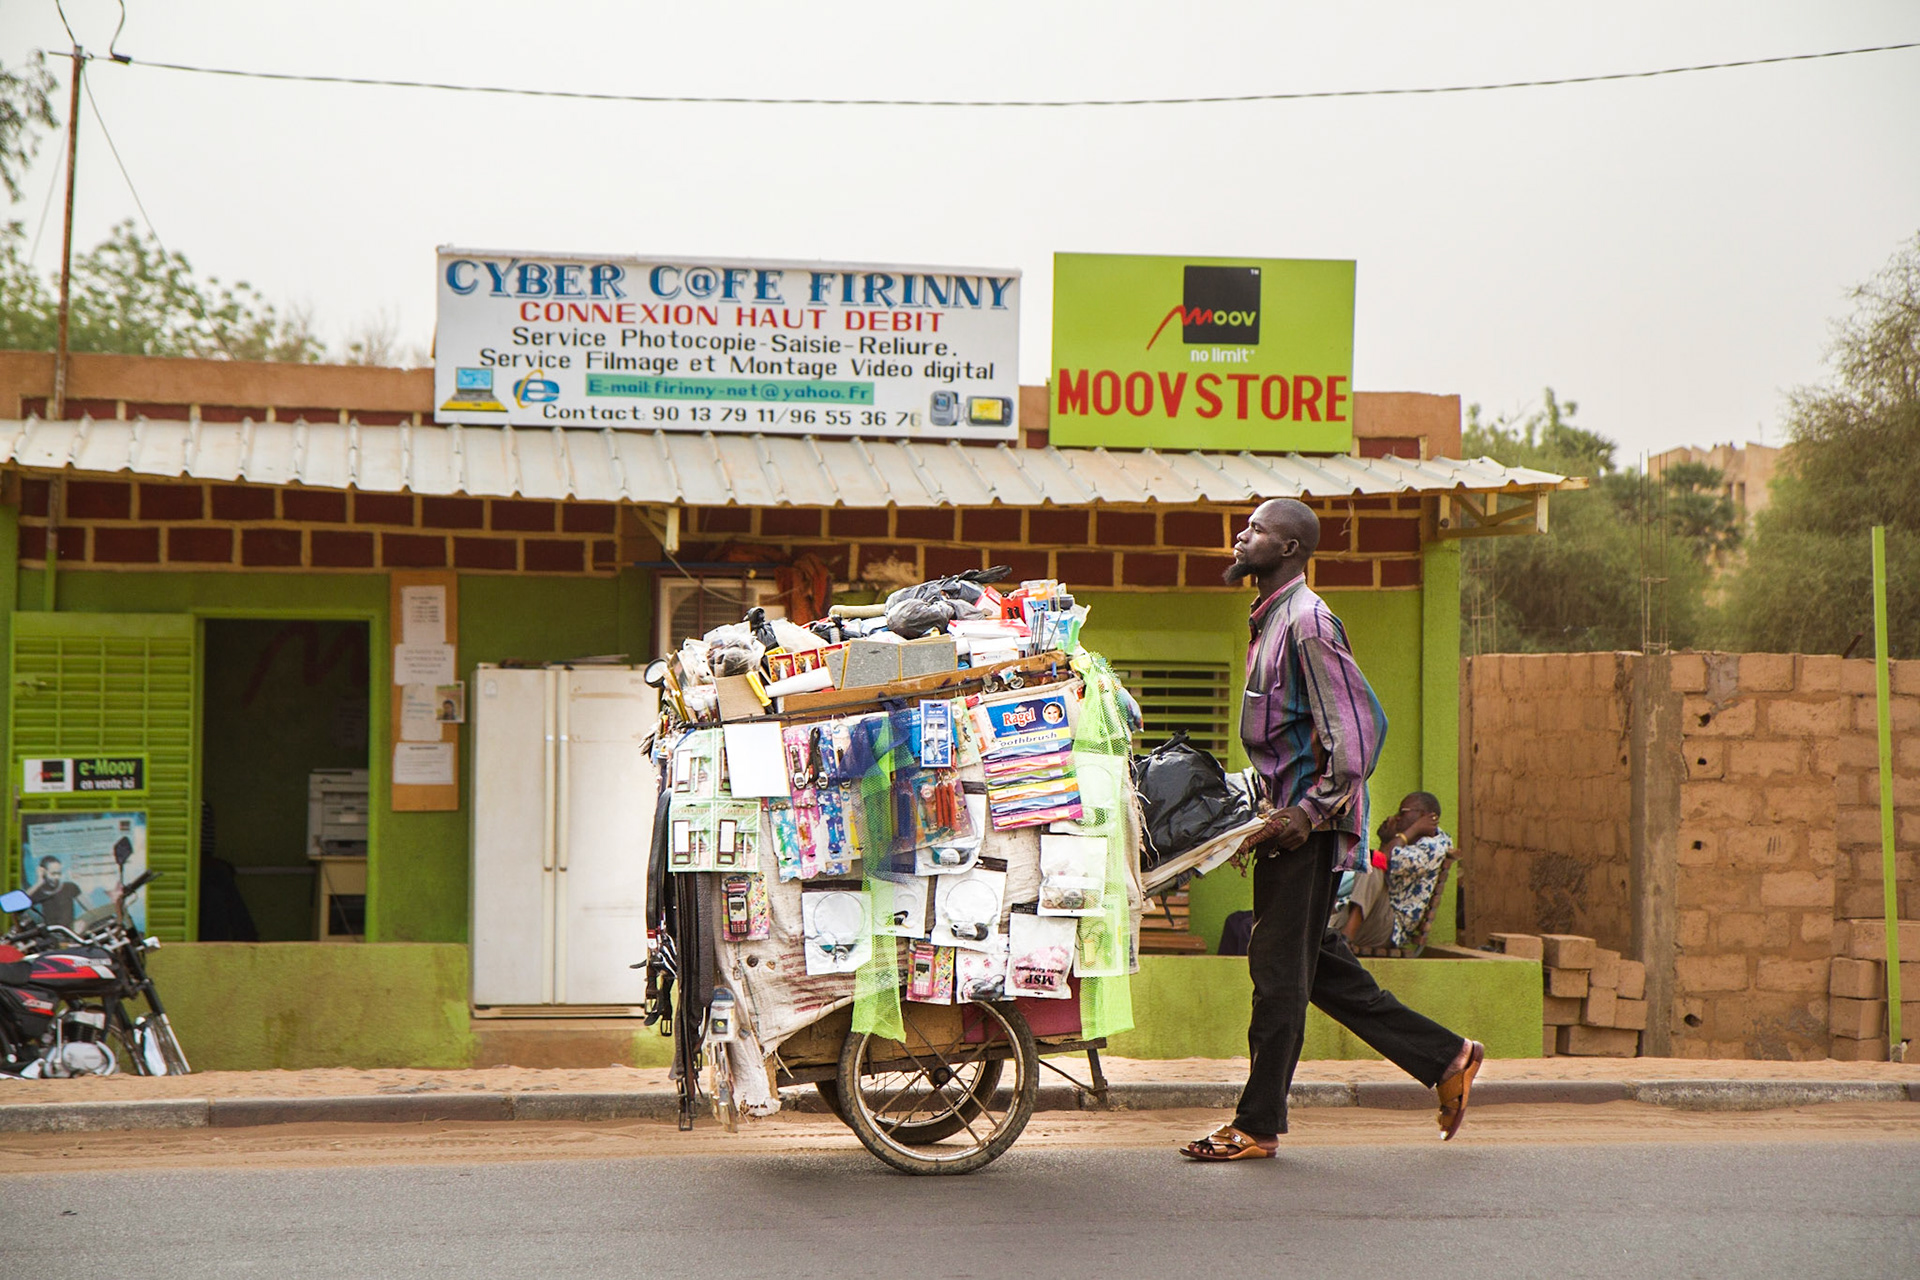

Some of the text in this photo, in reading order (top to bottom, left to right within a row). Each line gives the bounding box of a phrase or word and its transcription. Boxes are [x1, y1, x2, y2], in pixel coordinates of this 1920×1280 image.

[446, 259, 1014, 310] CYBER C@FE FIRINNY
[520, 302, 944, 332] CONNEXION HAUT DEBIT
[513, 327, 606, 347] Service
[1190, 349, 1209, 362] no
[480, 349, 571, 369] Service
[587, 352, 678, 375] Filmage
[690, 355, 715, 371] et
[730, 356, 837, 380] Montage
[924, 362, 994, 382] digital
[653, 406, 679, 421] 90
[690, 407, 711, 421] 13
[721, 407, 747, 422] 79
[826, 410, 851, 425] 55
[861, 411, 886, 426] 36
[1003, 707, 1036, 726] Ragel
[999, 733, 1057, 746] oothbrush
[78, 759, 136, 776] e-Moov
[80, 776, 135, 790] en vente ici
[1025, 974, 1054, 985] MSP
